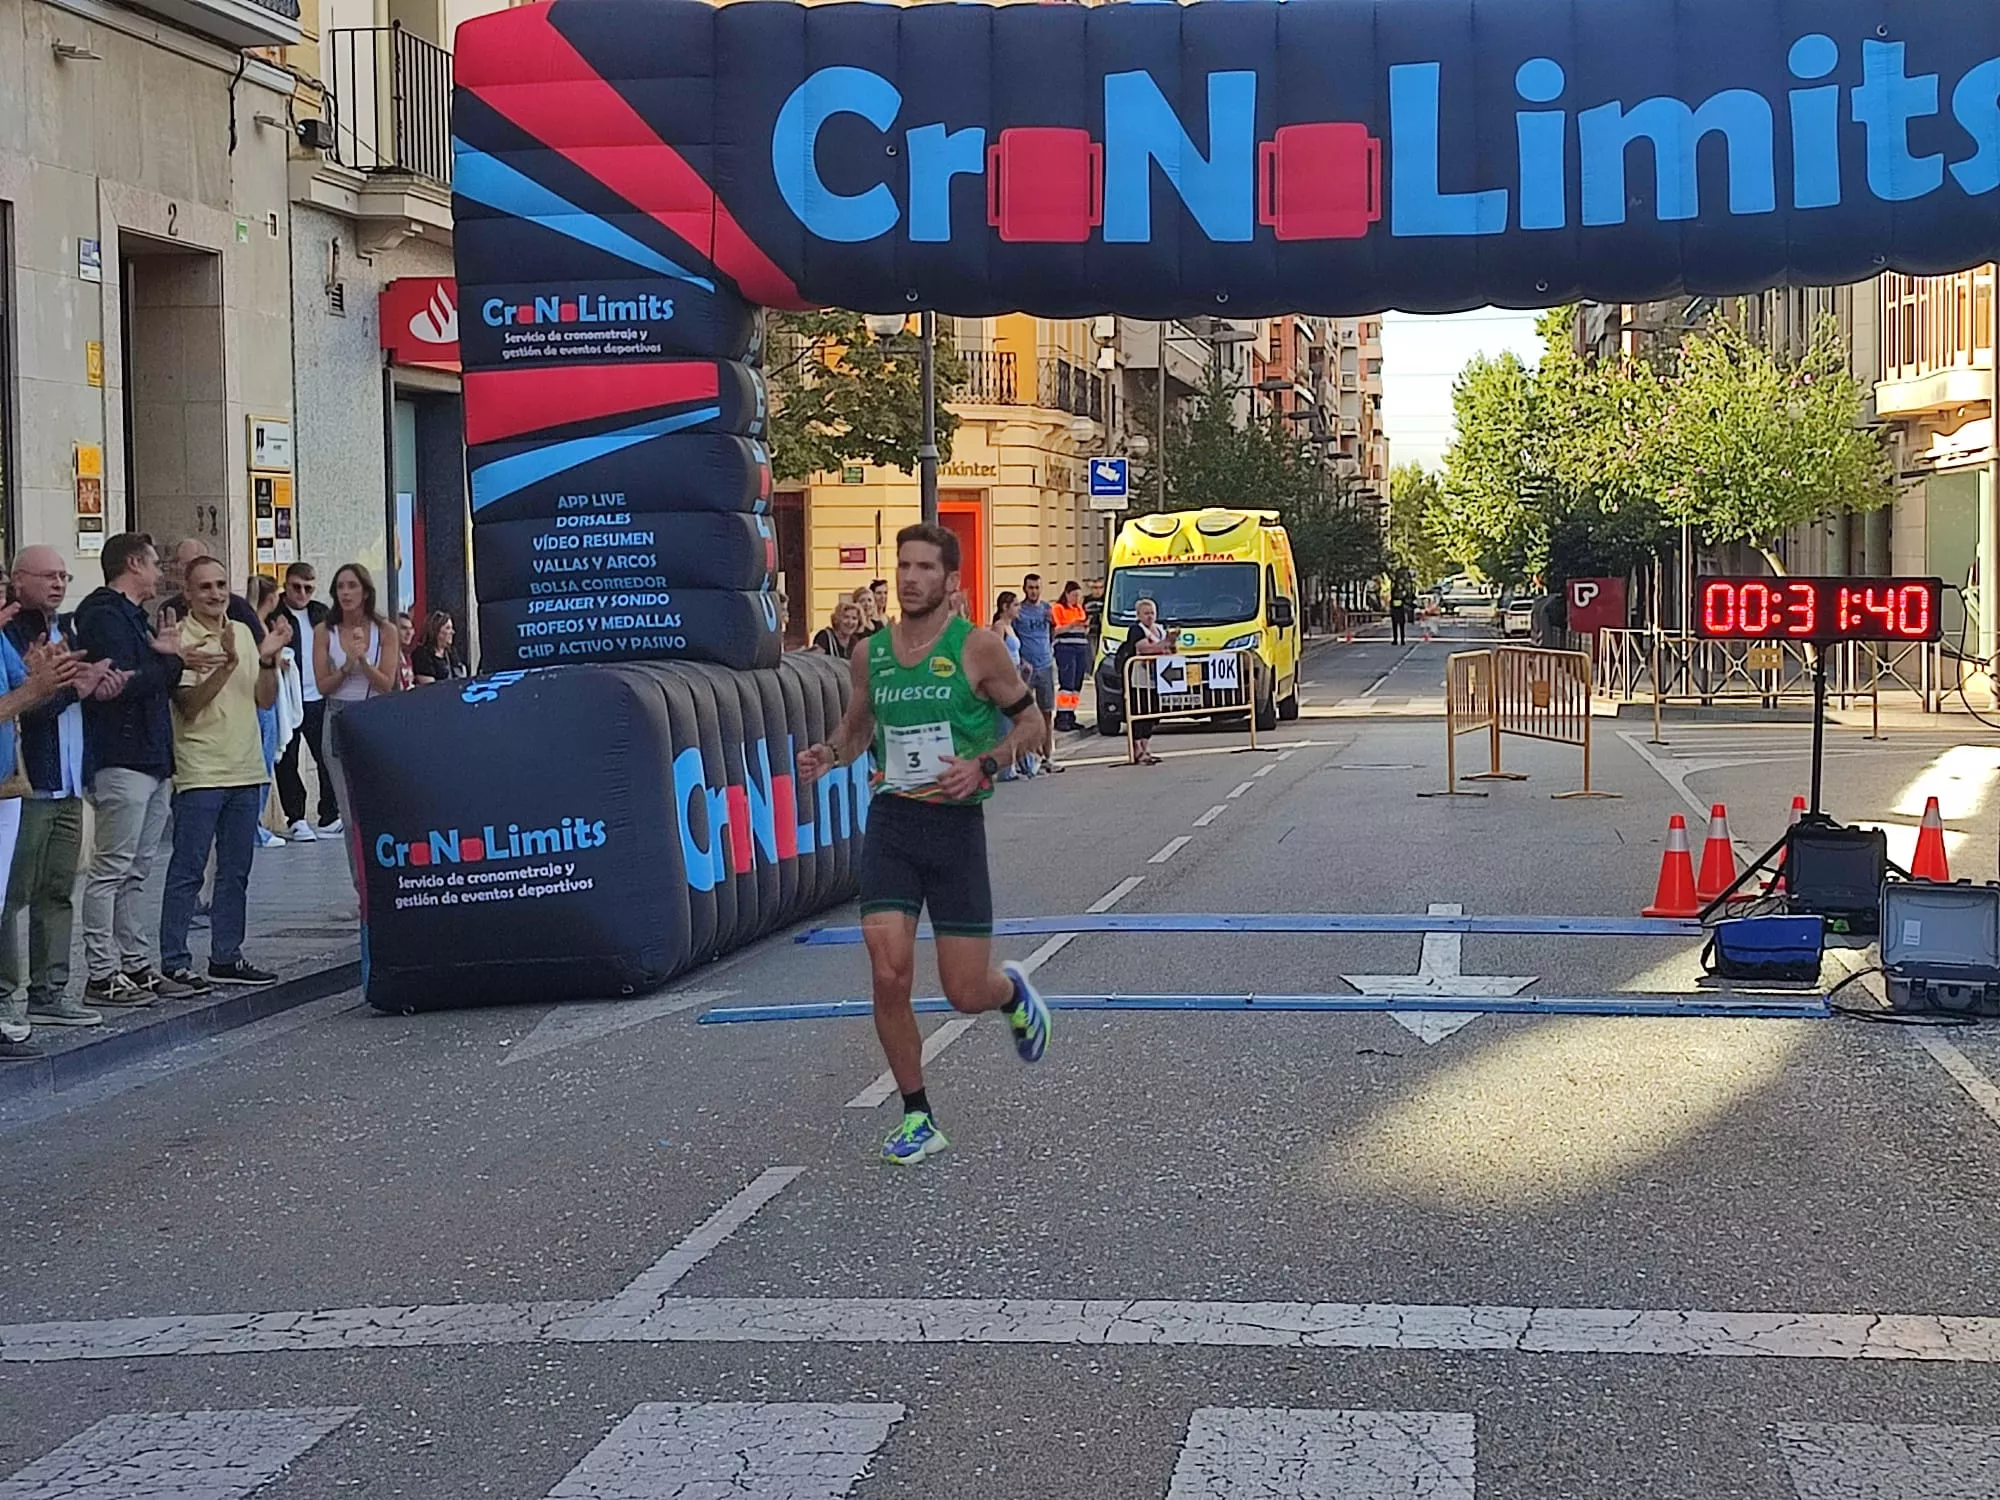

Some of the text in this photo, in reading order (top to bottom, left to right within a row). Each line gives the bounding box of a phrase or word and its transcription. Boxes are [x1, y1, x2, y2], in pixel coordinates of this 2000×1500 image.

[167, 203, 178, 236] 2
[504, 328, 648, 343] Servicio de cronometraje y
[502, 343, 662, 360] gestión de eventos deportivos
[557, 493, 627, 509] APP LIVE
[556, 512, 631, 528] DORSALES
[532, 532, 655, 550] VÍDEO RESUMEN
[532, 554, 657, 573] VALLAS Y ARCOS
[530, 576, 668, 595] BOLSA CORREDOR
[527, 593, 670, 614] SPEAKER Y SONIDO
[517, 613, 683, 638] TROFEOS Y MEDALLAS
[518, 636, 687, 659] CHIP ACTIVO Y PASIVO
[1210, 658, 1236, 679] 10K
[874, 685, 952, 704] Huesca
[907, 751, 921, 768] 3
[398, 863, 575, 889] Servicio de cronometraje y
[395, 877, 594, 909] gestión de eventos deportivos
